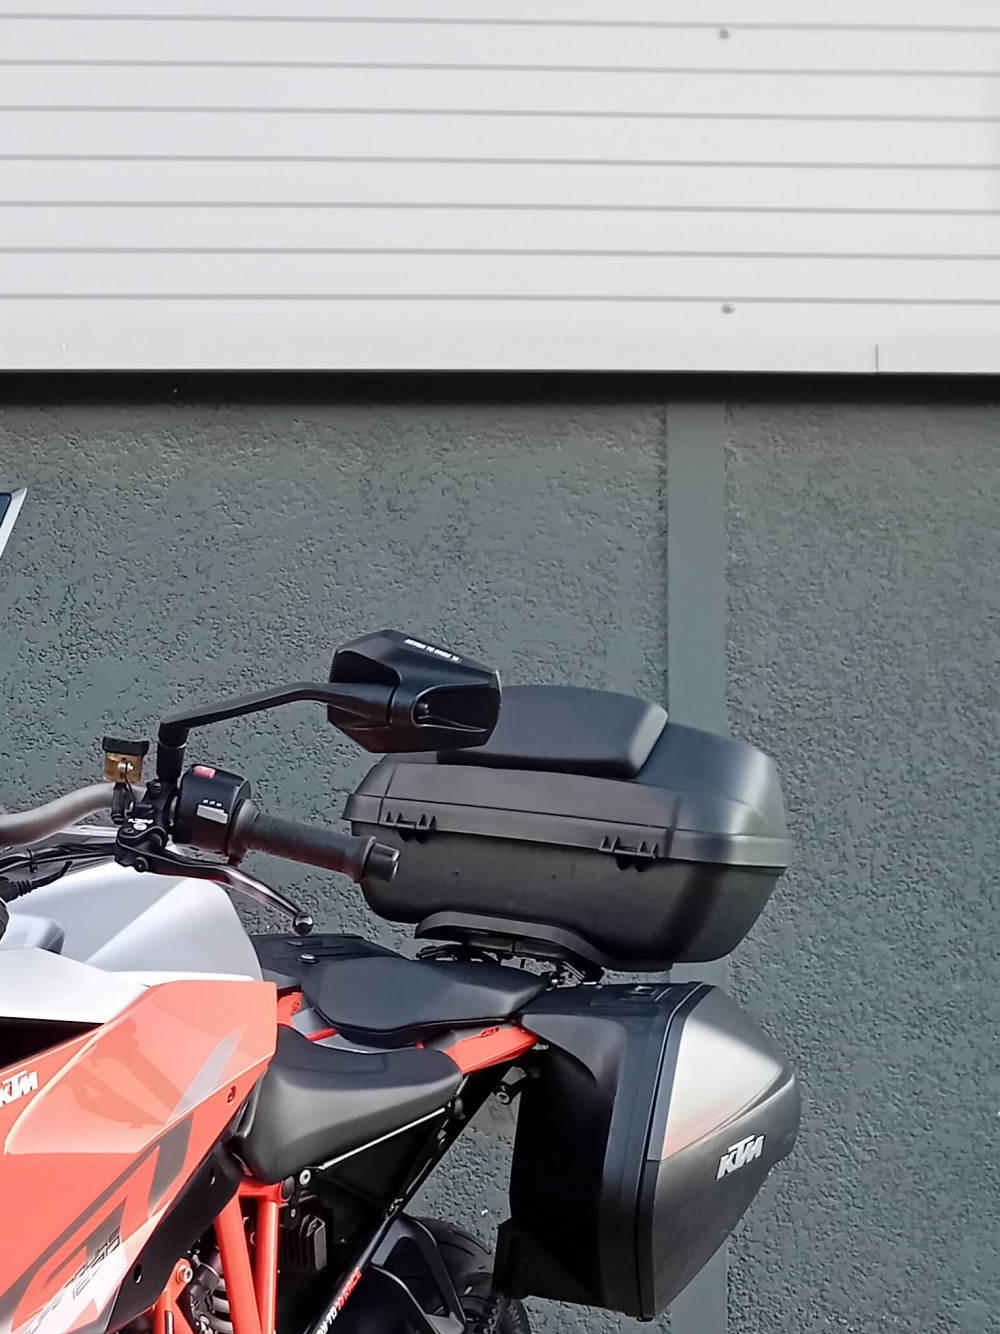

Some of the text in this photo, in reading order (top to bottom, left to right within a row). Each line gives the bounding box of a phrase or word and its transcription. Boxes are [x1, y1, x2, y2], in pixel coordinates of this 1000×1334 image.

[716, 1133, 765, 1180] KTM
[325, 1305, 338, 1325] TO
[340, 1266, 362, 1300] RACE
